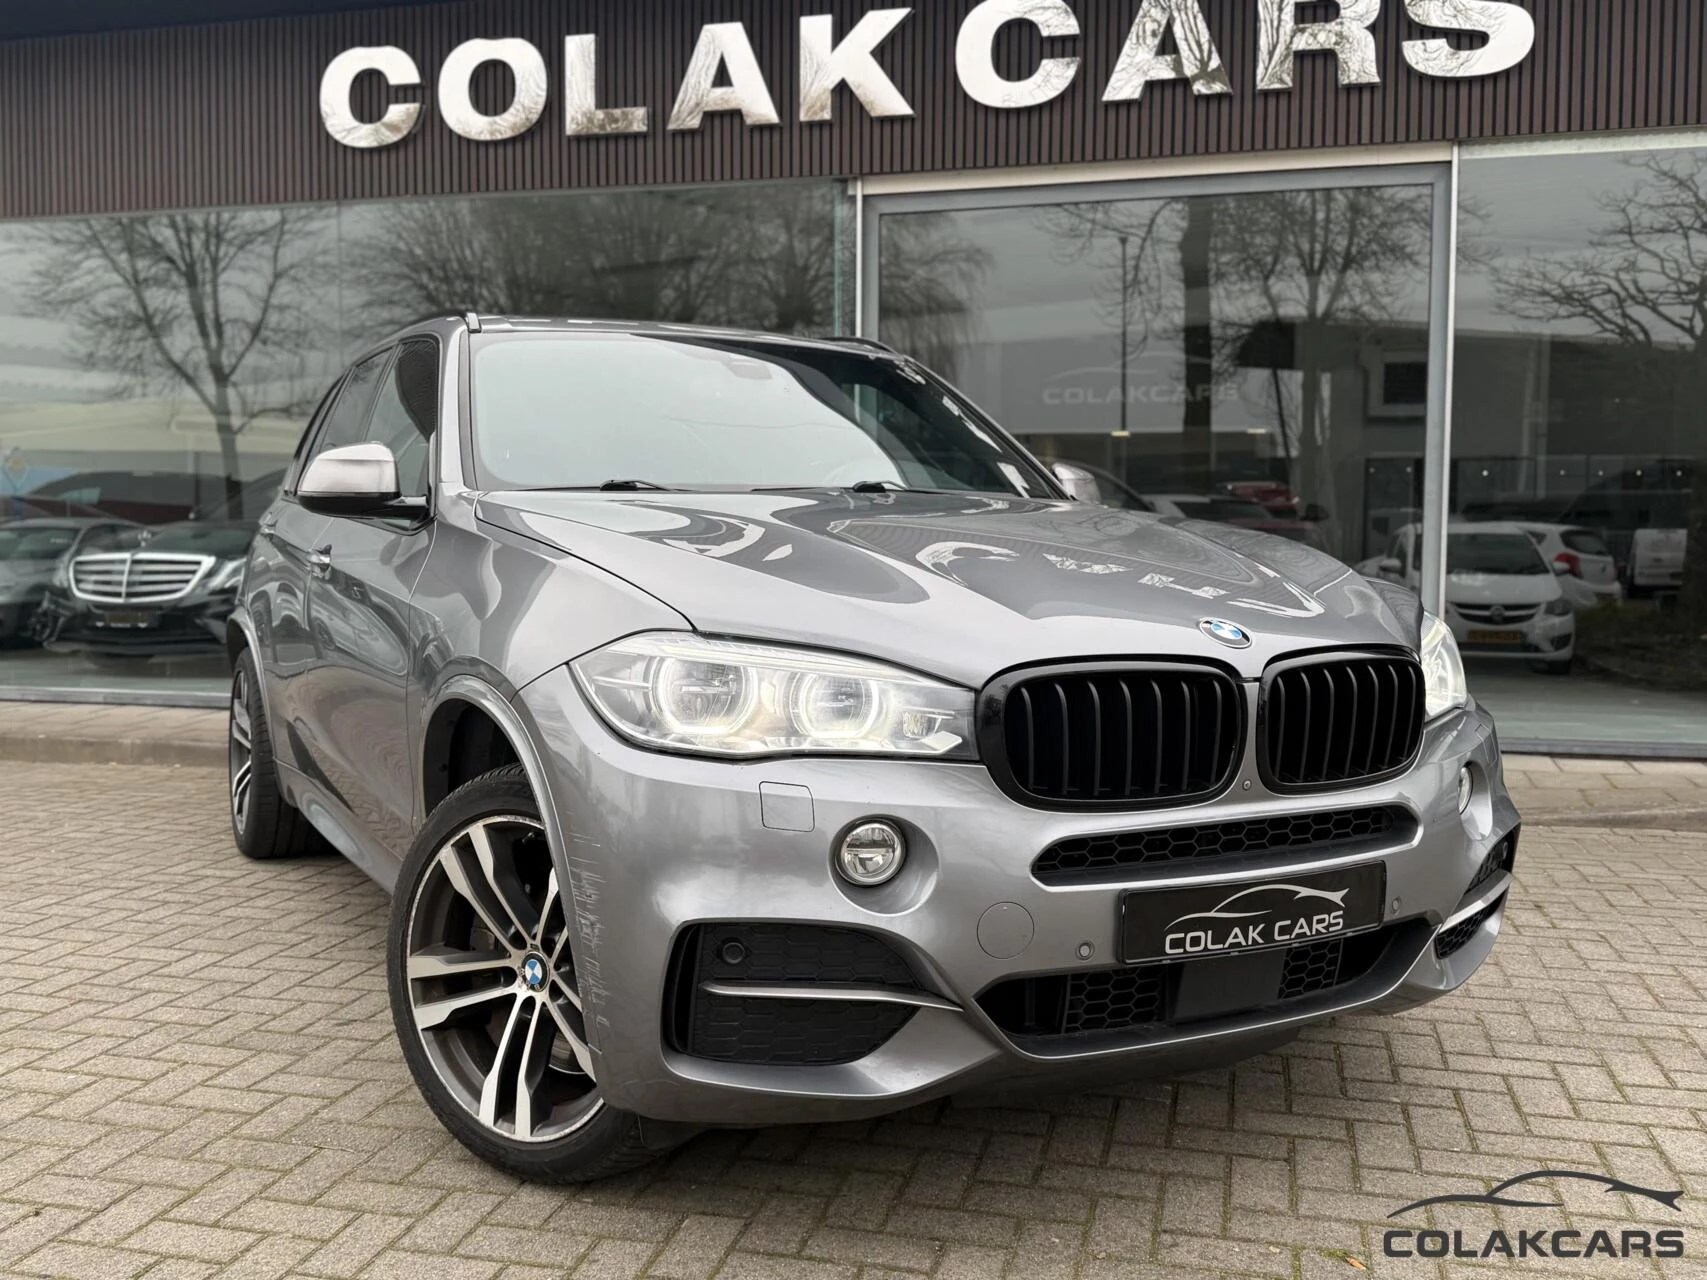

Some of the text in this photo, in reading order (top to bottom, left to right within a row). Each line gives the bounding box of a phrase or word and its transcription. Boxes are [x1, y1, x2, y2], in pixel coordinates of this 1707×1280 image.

[319, 0, 1536, 149] COLAK CARS
[1164, 910, 1344, 955] COLAK CARS
